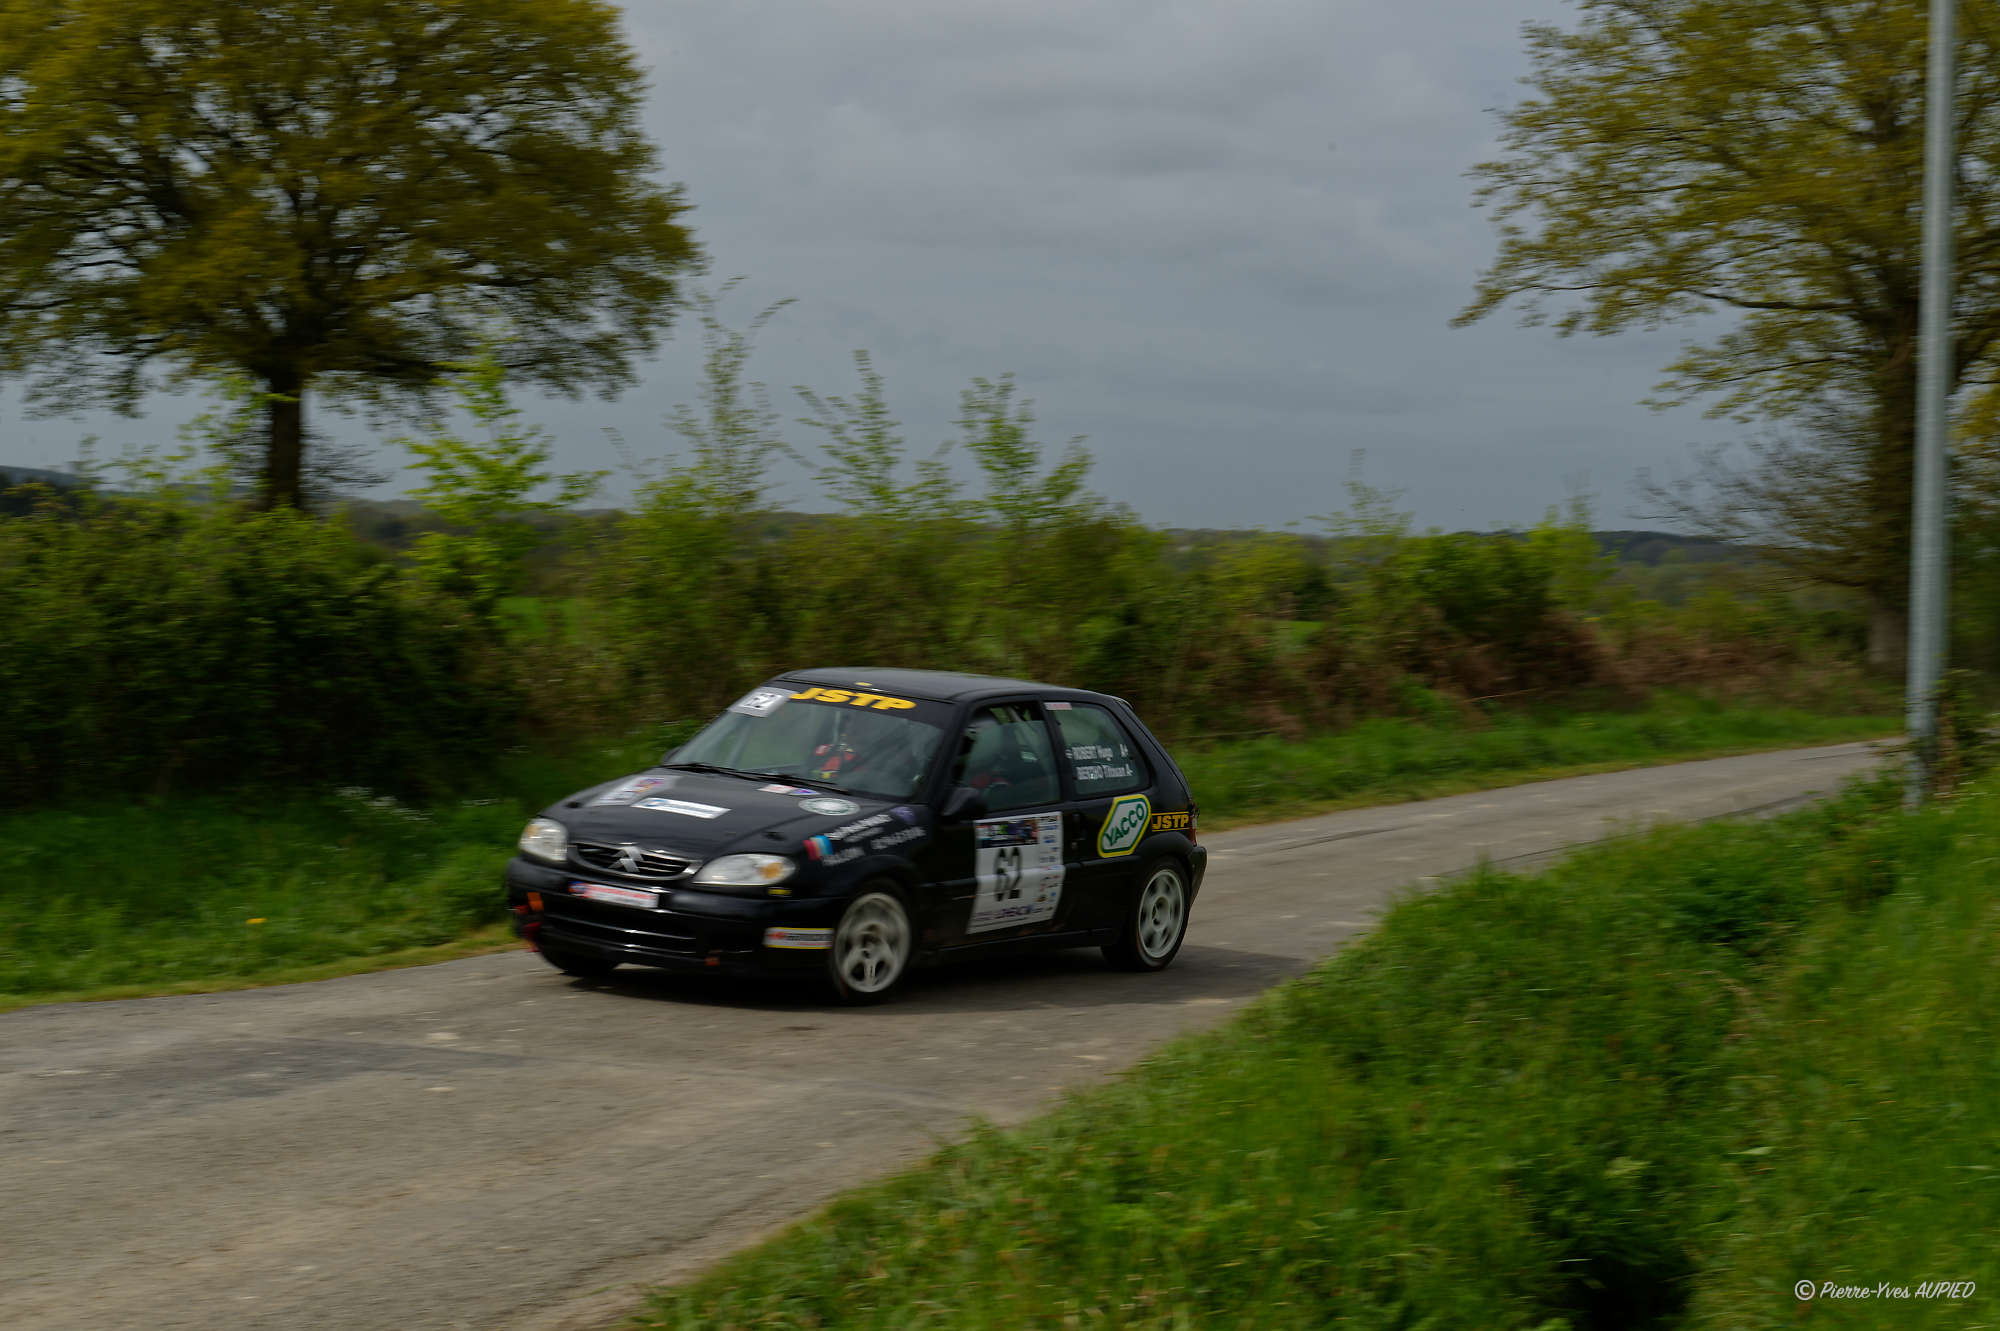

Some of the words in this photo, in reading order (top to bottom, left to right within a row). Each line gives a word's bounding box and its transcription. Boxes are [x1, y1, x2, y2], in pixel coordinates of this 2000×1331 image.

[788, 687, 917, 711] JSTP
[1103, 803, 1145, 847] YACCO
[1151, 814, 1190, 830] JSTP
[993, 846, 1023, 902] 62
